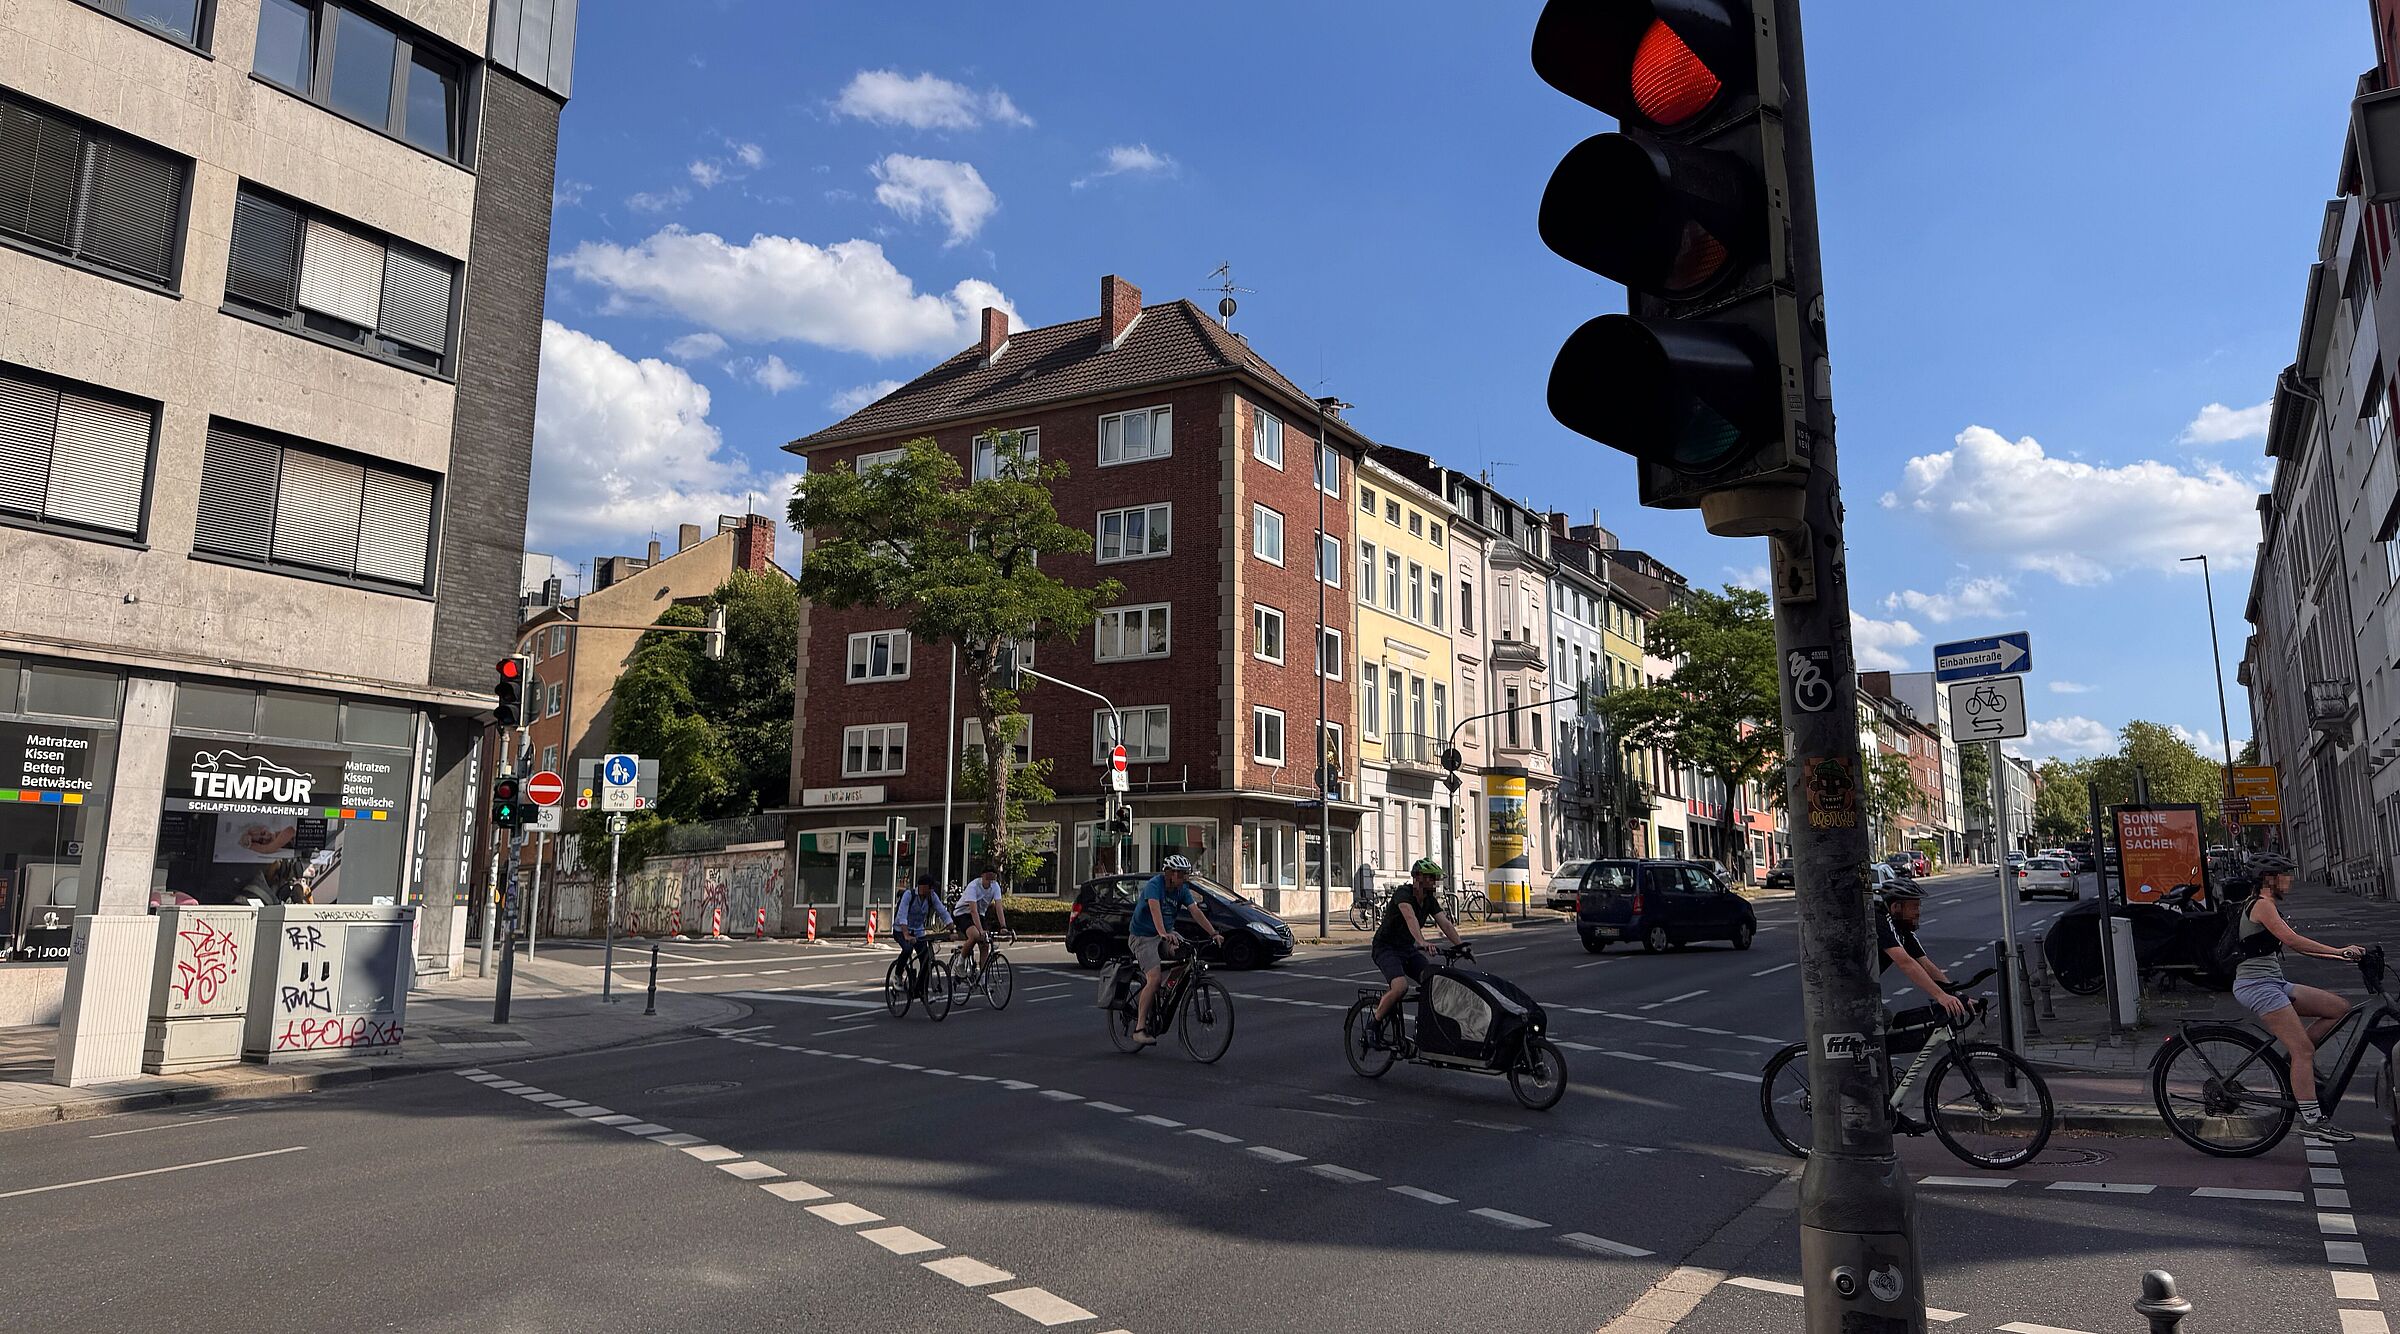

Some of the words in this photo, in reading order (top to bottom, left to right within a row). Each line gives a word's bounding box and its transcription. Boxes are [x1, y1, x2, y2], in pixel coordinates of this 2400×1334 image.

[1940, 651, 2002, 668] Einbahnstraße
[26, 734, 88, 749] Matratzen
[25, 748, 64, 761] Kissen
[23, 761, 65, 775] Betten
[345, 760, 391, 774] Matratzen
[21, 775, 93, 790] Bettwäsche
[343, 772, 374, 785] Kissen
[191, 771, 312, 803] TEMPUR
[342, 783, 374, 796] Betten
[188, 801, 309, 816] SCHLAFSTUDIO-AACHEN.DE
[341, 795, 395, 808] Bettwäsche
[414, 721, 434, 883] TEMPUR
[459, 736, 479, 885] TEMPUR
[2123, 813, 2167, 824] SONNE
[2124, 826, 2158, 837] GUTE
[1900, 1044, 1936, 1088] CANYON
